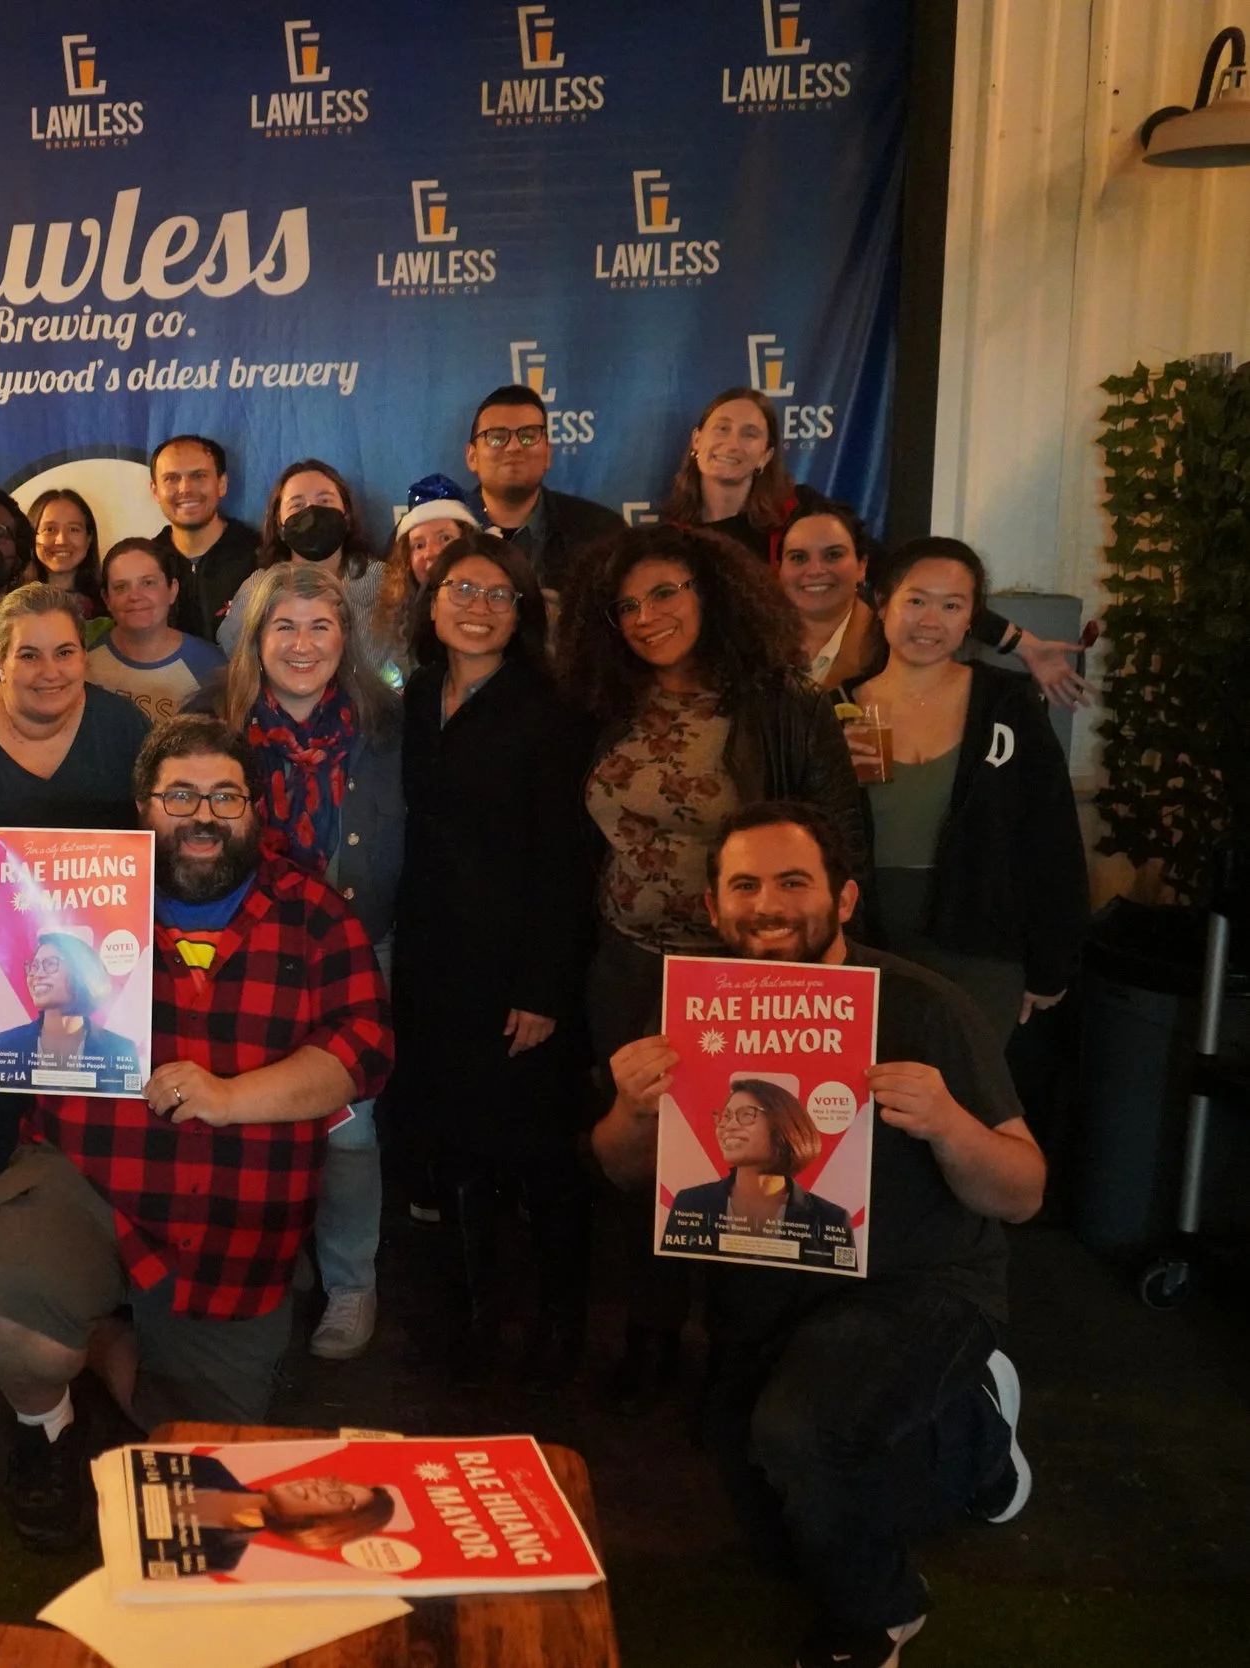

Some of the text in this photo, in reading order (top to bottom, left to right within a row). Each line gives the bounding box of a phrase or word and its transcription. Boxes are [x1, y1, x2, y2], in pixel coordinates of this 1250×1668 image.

[722, 63, 851, 104] LAWLESS
[481, 76, 604, 116] LAWLESS
[251, 89, 368, 128] LAWLESS
[738, 103, 805, 113] BREWING
[31, 102, 144, 140] LAWLESS
[496, 115, 561, 126] BREWING
[265, 127, 328, 138] BREWING
[46, 139, 105, 150] BREWING
[377, 249, 496, 287] LAWLESS
[595, 240, 720, 278] LAWLESS
[392, 286, 455, 296] BREWING
[611, 279, 677, 289] BREWING
[145, 311, 196, 338] co.
[127, 359, 221, 391] oldest
[229, 357, 358, 396] brewery
[985, 723, 1015, 768] D
[1, 856, 136, 883] RAE HUANG
[42, 884, 127, 910] MAYOR
[106, 943, 134, 951] VOTE!
[686, 995, 854, 1021] RAE HUANG
[735, 1028, 842, 1054] MAYOR
[15, 1072, 26, 1080] LA
[814, 1097, 849, 1106] VOTE!
[675, 1210, 703, 1219] Housing
[714, 1222, 730, 1230] Free
[778, 1221, 810, 1231] Economy
[788, 1230, 812, 1239] People
[826, 1225, 846, 1233] REAL
[665, 1235, 686, 1245] RAE
[698, 1236, 712, 1245] LA
[824, 1234, 847, 1243] Safety
[455, 1452, 504, 1490] RAE
[425, 1486, 498, 1559] MAYOR
[478, 1493, 552, 1565] HUANG
